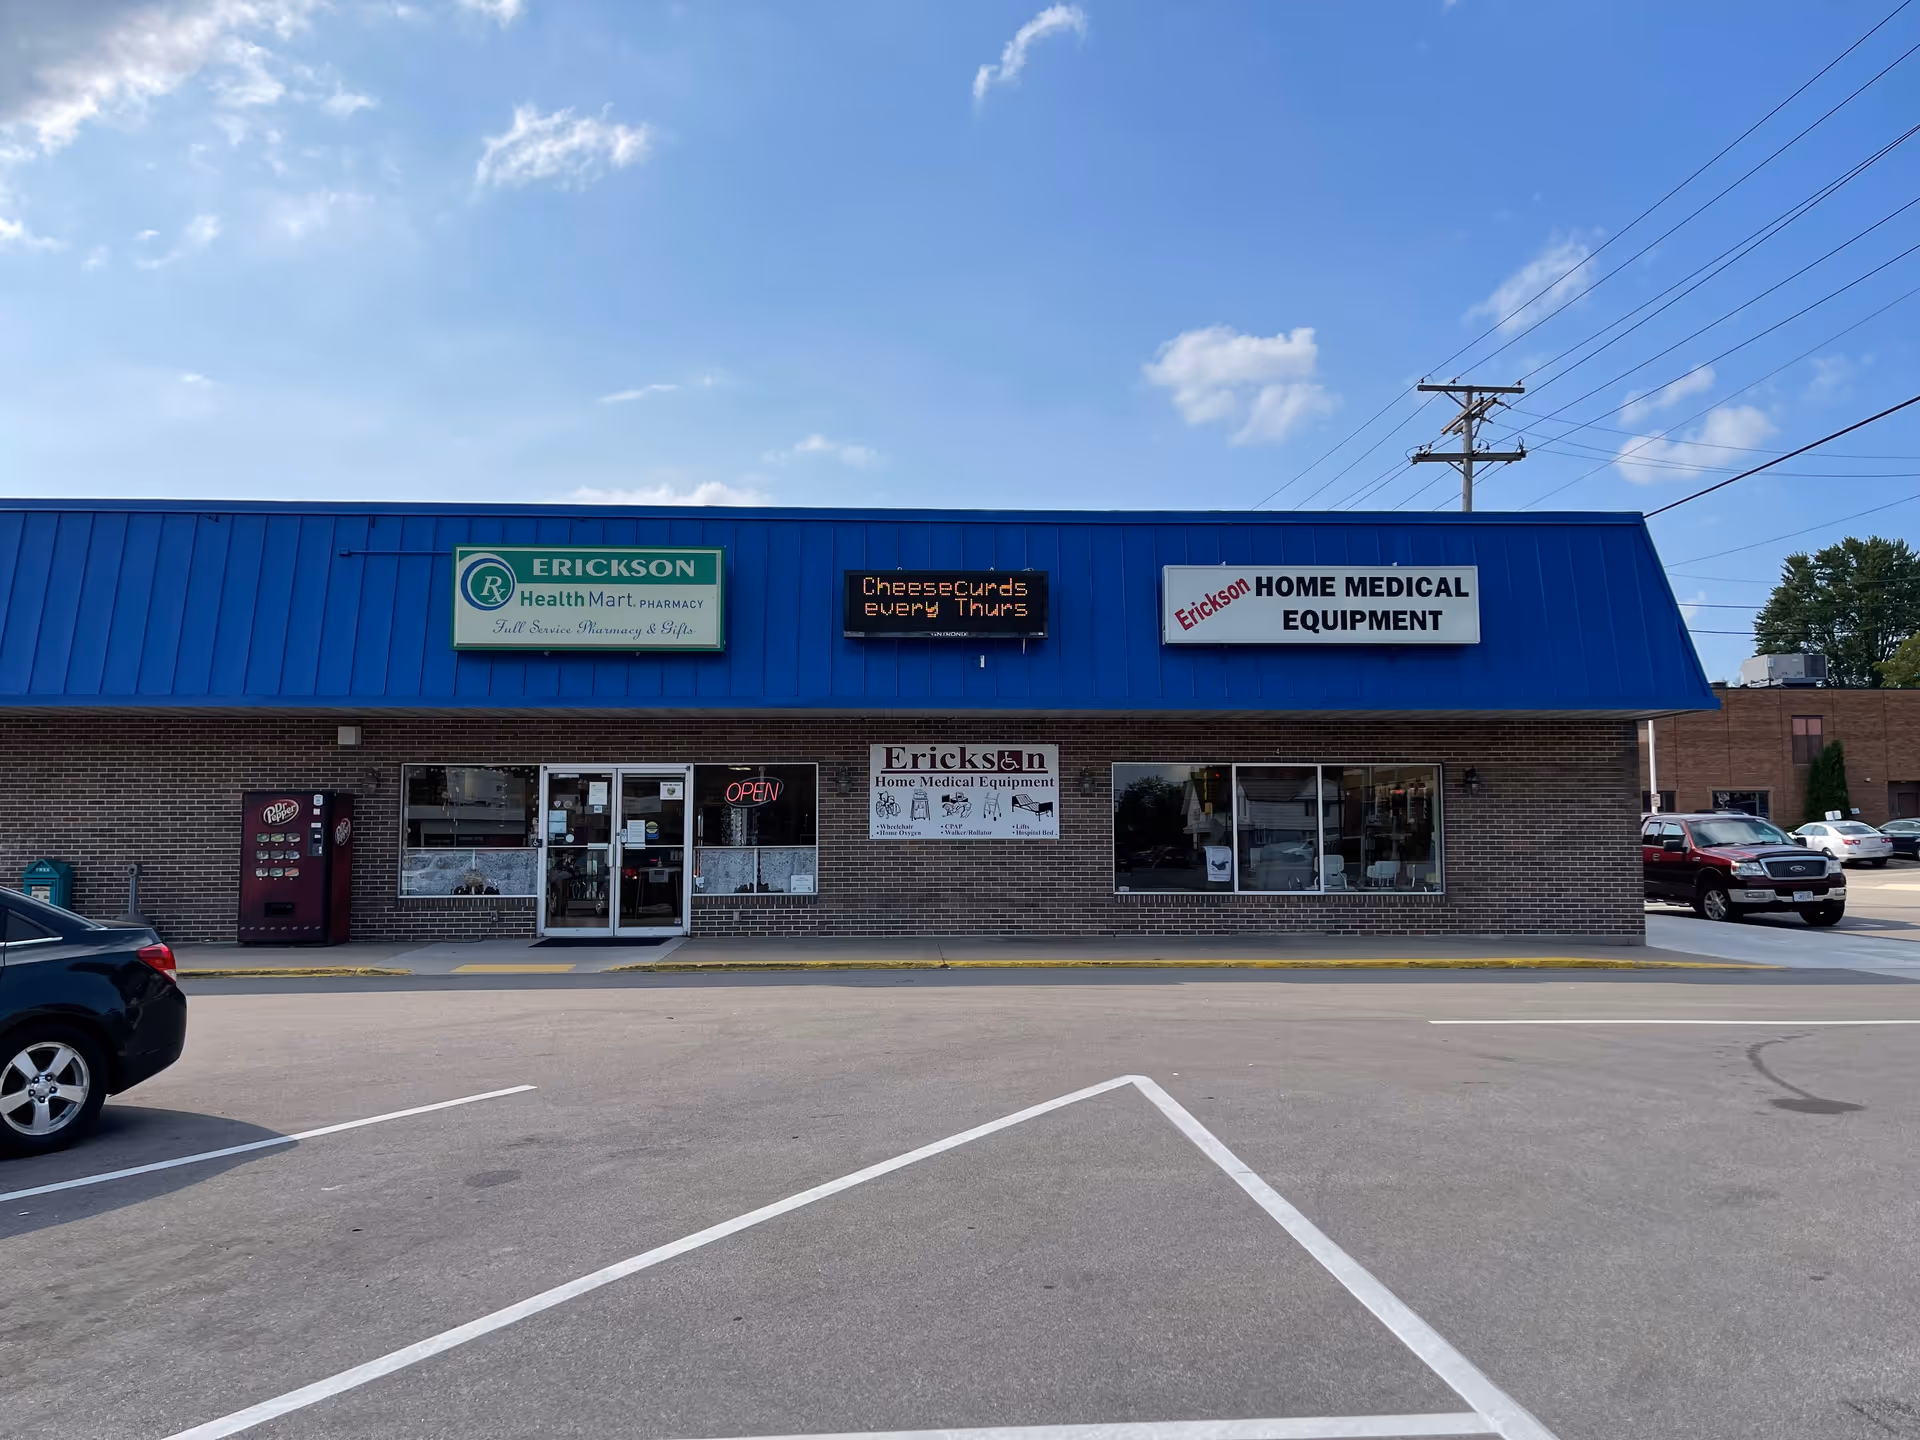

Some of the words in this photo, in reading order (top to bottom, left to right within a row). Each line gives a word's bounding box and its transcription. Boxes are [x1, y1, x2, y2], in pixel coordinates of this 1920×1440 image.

[533, 559, 695, 577] ERICKSON
[1256, 576, 1335, 596] HOME
[1345, 577, 1469, 597] MEDICAL
[640, 600, 703, 609] PHARMACY
[865, 601, 938, 617] every
[955, 598, 1028, 616] Thurs
[1175, 578, 1251, 630] Erickson
[493, 620, 525, 634] Full
[530, 620, 572, 634] Service
[576, 620, 642, 640] Pharmacy
[646, 621, 656, 634] &
[661, 620, 693, 639] Gifts
[1283, 610, 1443, 633] EQUIPMENT
[726, 782, 779, 802] OPEN
[875, 777, 915, 787] Home
[920, 776, 974, 787] Medical
[979, 776, 1055, 789] Equipment
[267, 805, 295, 823] Pepper
[275, 803, 287, 812] Dr
